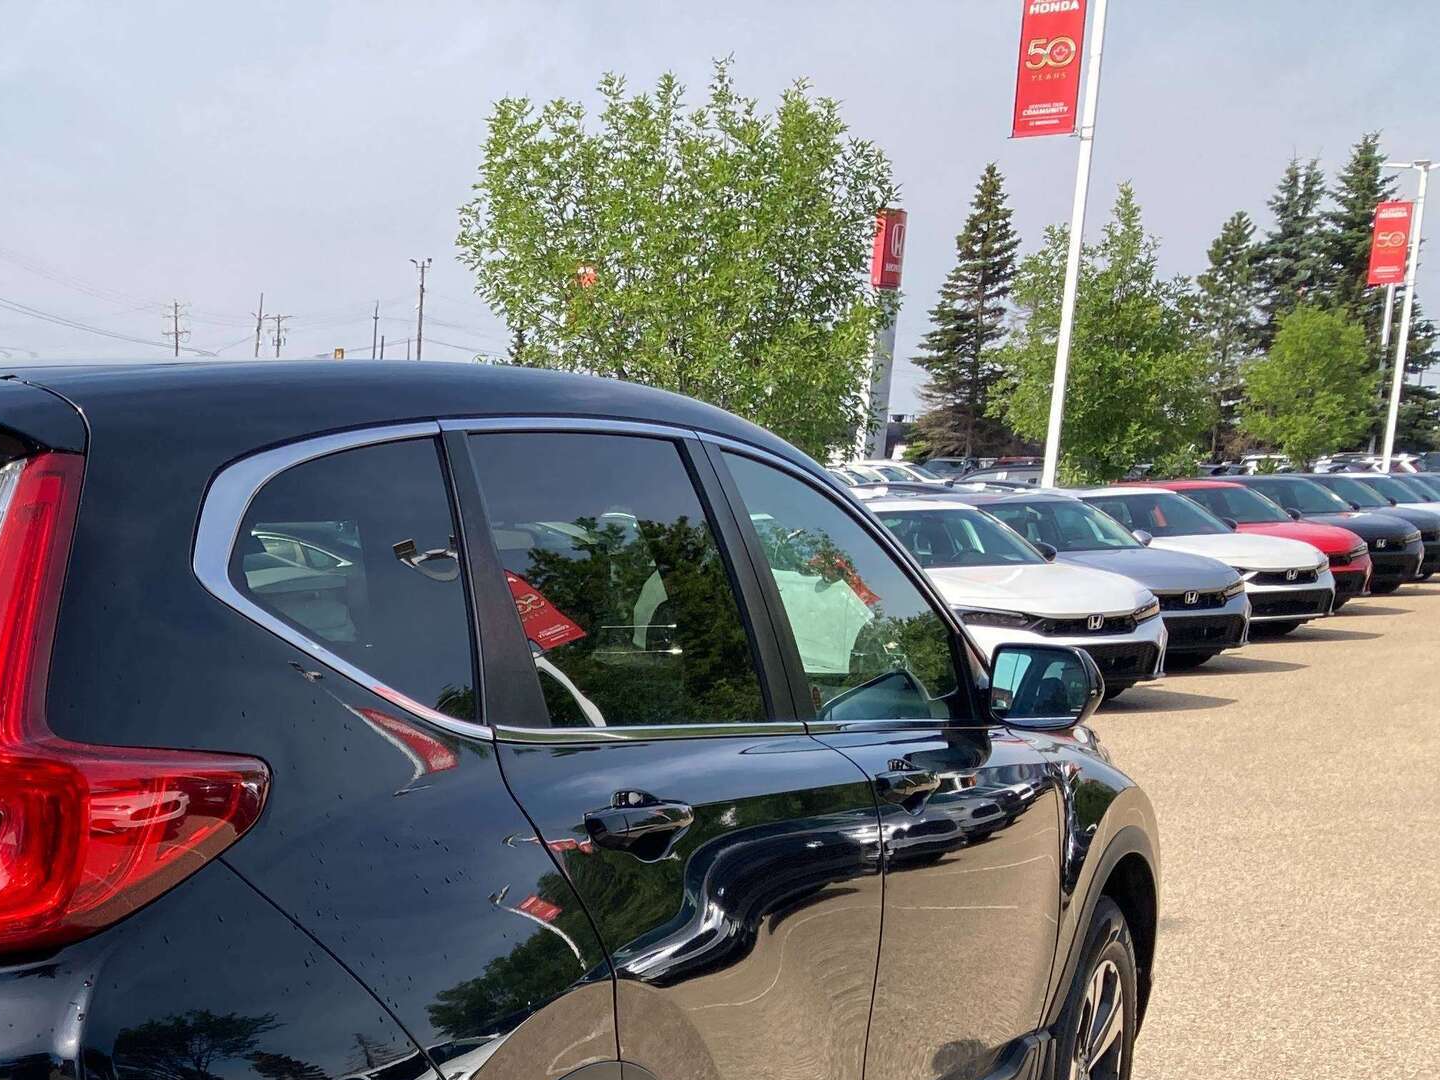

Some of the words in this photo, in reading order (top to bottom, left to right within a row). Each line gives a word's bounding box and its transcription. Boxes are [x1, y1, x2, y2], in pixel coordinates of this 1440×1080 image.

[1029, 0, 1080, 15] HONDA
[1025, 36, 1077, 70] 50
[1376, 231, 1406, 248] 50
